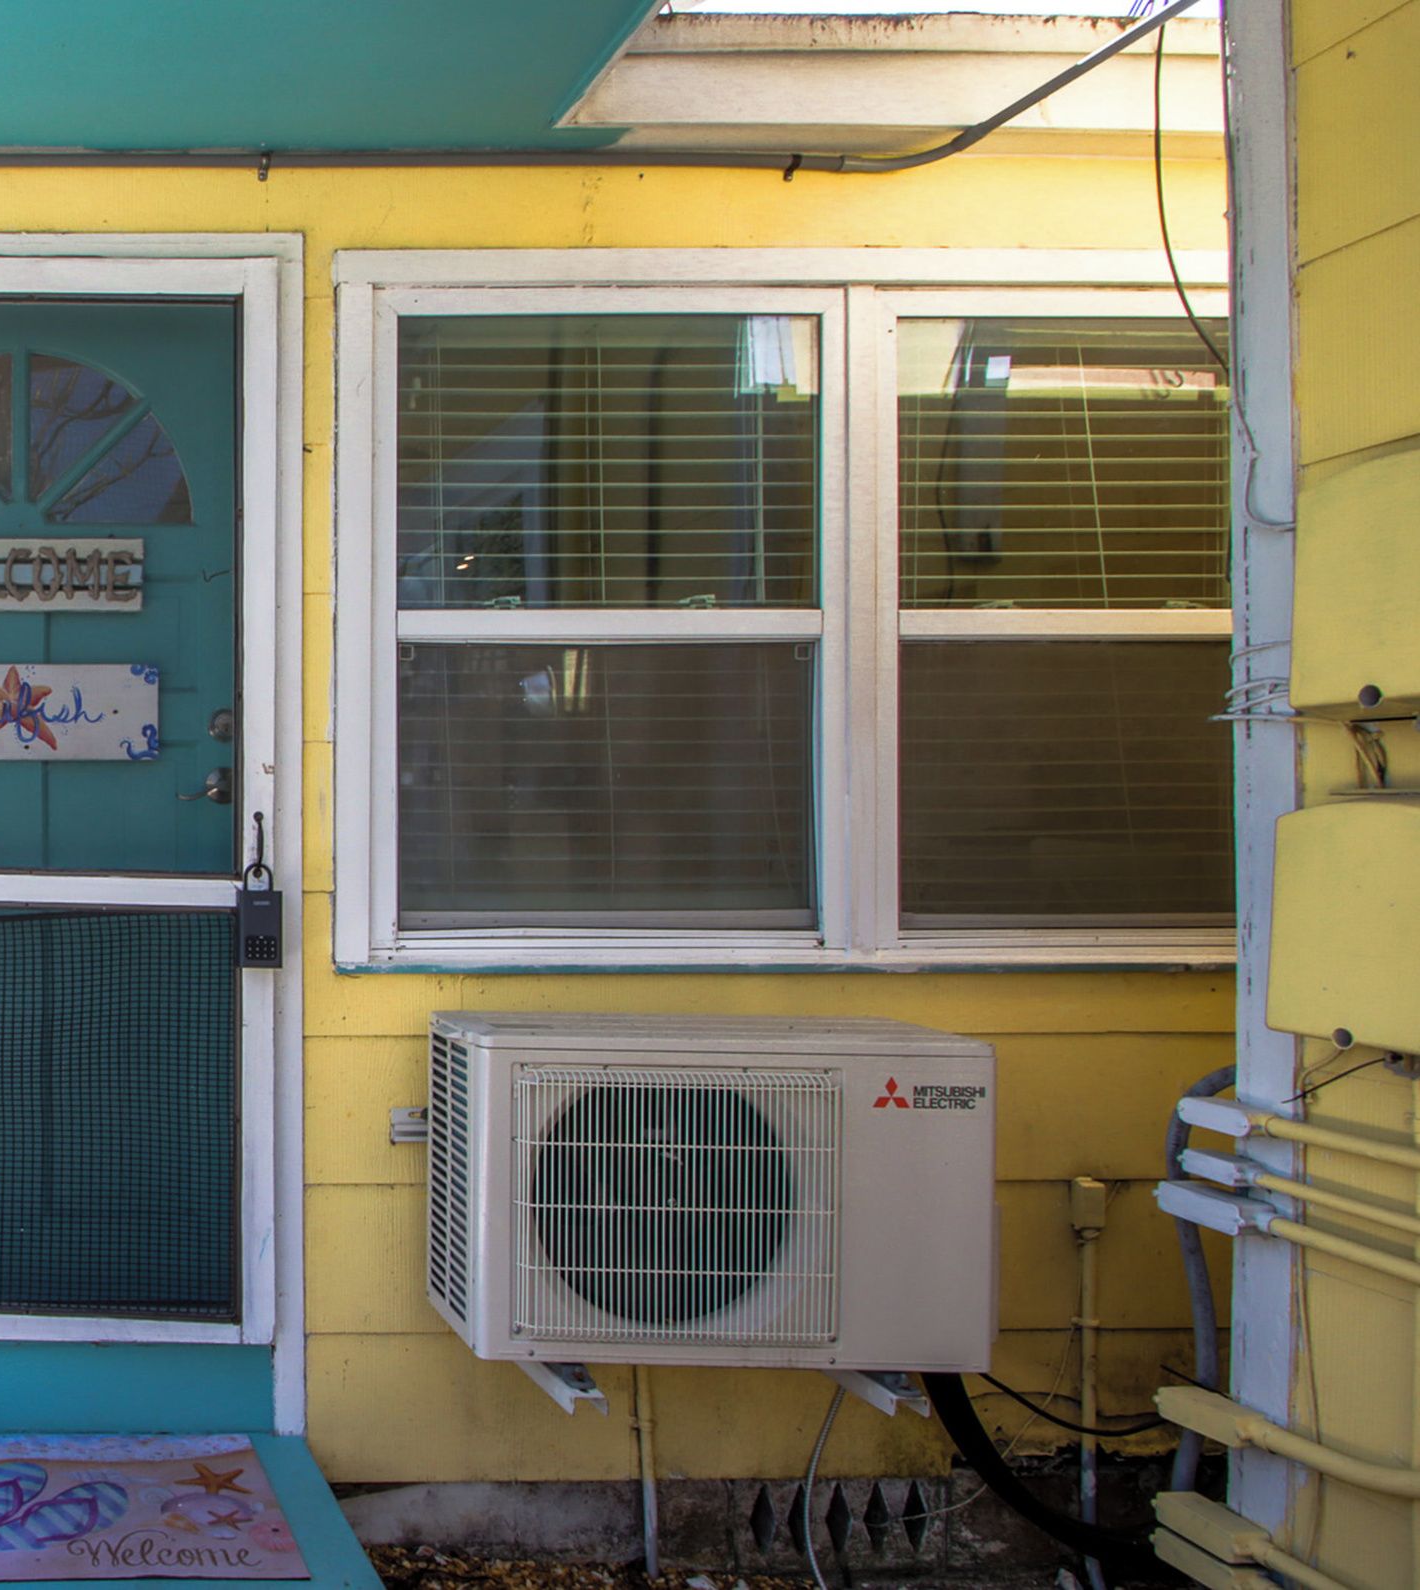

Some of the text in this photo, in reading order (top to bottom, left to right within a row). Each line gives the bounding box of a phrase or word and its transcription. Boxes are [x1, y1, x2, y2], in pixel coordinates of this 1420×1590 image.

[913, 1086, 985, 1098] MITSUBISHI
[913, 1098, 976, 1109] ELECTRIC
[67, 1529, 262, 1568] Welcome
